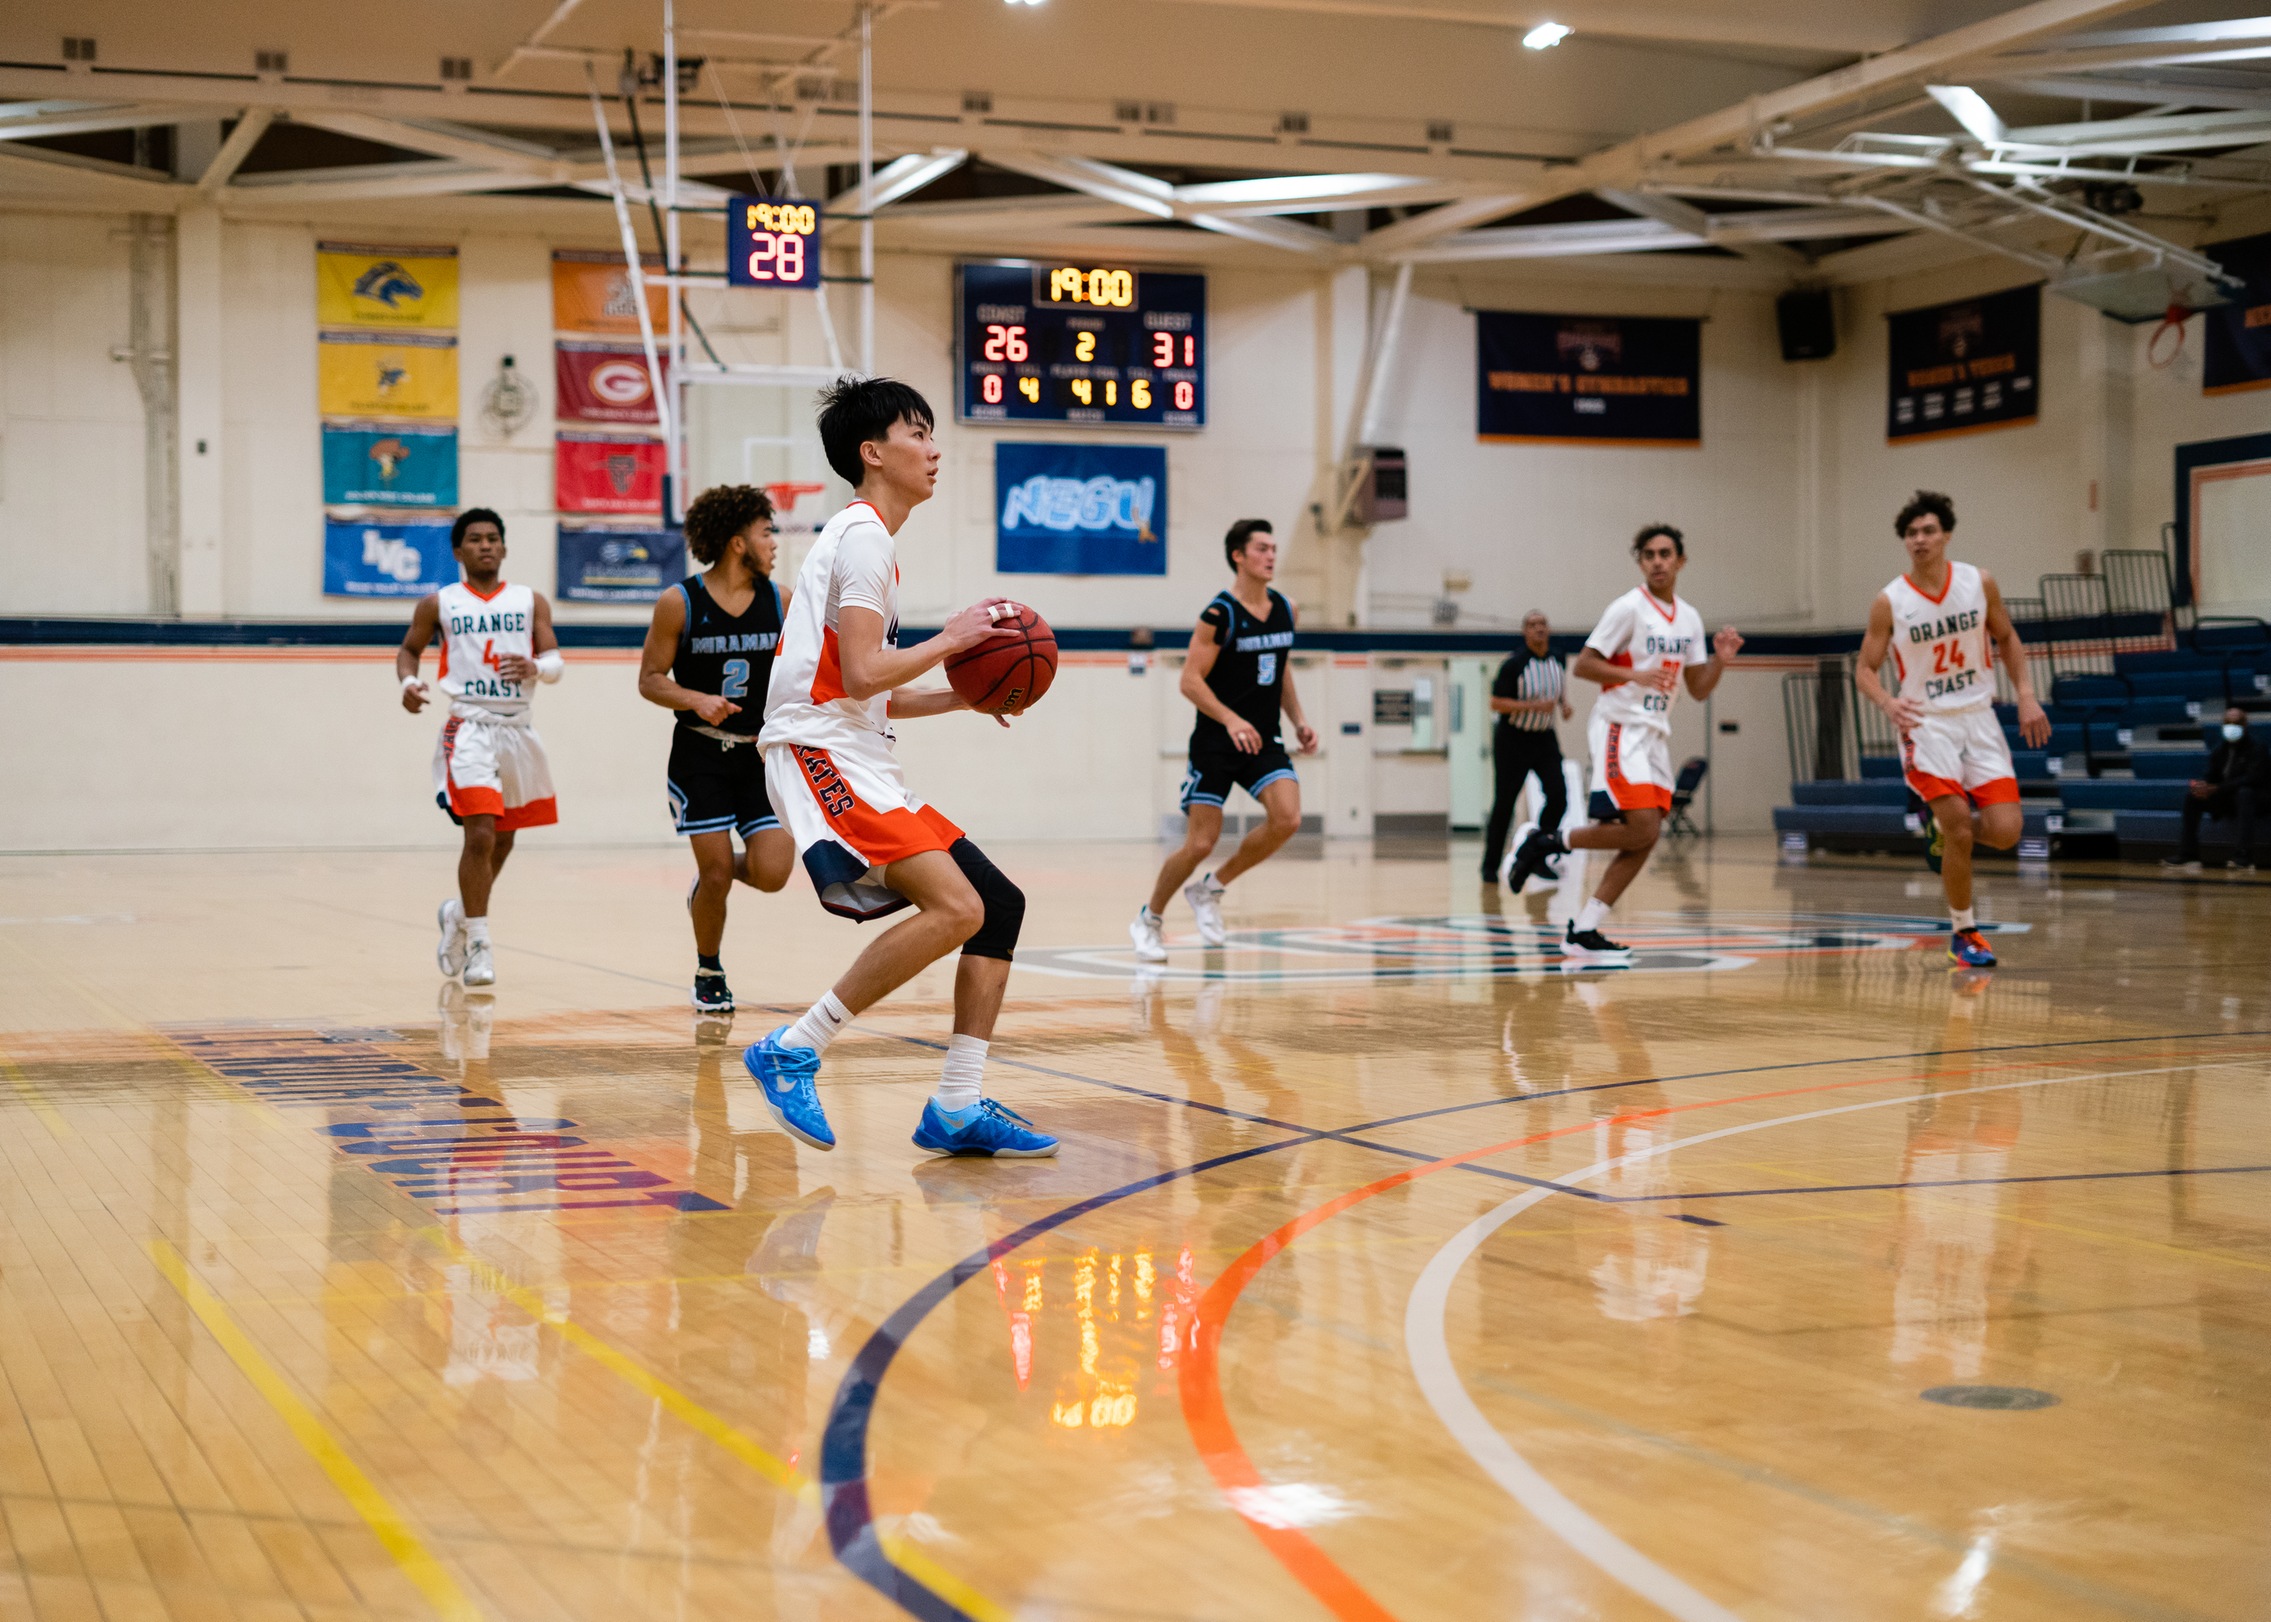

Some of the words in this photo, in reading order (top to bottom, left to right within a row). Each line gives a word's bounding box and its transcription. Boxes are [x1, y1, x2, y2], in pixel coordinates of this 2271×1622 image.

[747, 203, 815, 235] 19:00
[749, 232, 804, 281] 28
[1051, 267, 1132, 307] 19:00
[985, 325, 1028, 361] 26
[1076, 331, 1096, 362] 2
[1153, 332, 1194, 367] 31
[594, 364, 647, 402] G
[983, 373, 1002, 404] 0
[1019, 376, 1039, 403] 4
[1131, 379, 1152, 410] 6
[1174, 381, 1194, 410] 0
[451, 612, 525, 636] ORANGE
[1909, 609, 1979, 644] ORANGE
[1257, 652, 1277, 686] 5
[1933, 638, 1965, 674] 24
[721, 658, 750, 699] 2
[1925, 668, 1976, 699] COAST
[313, 1116, 735, 1217] COURT
